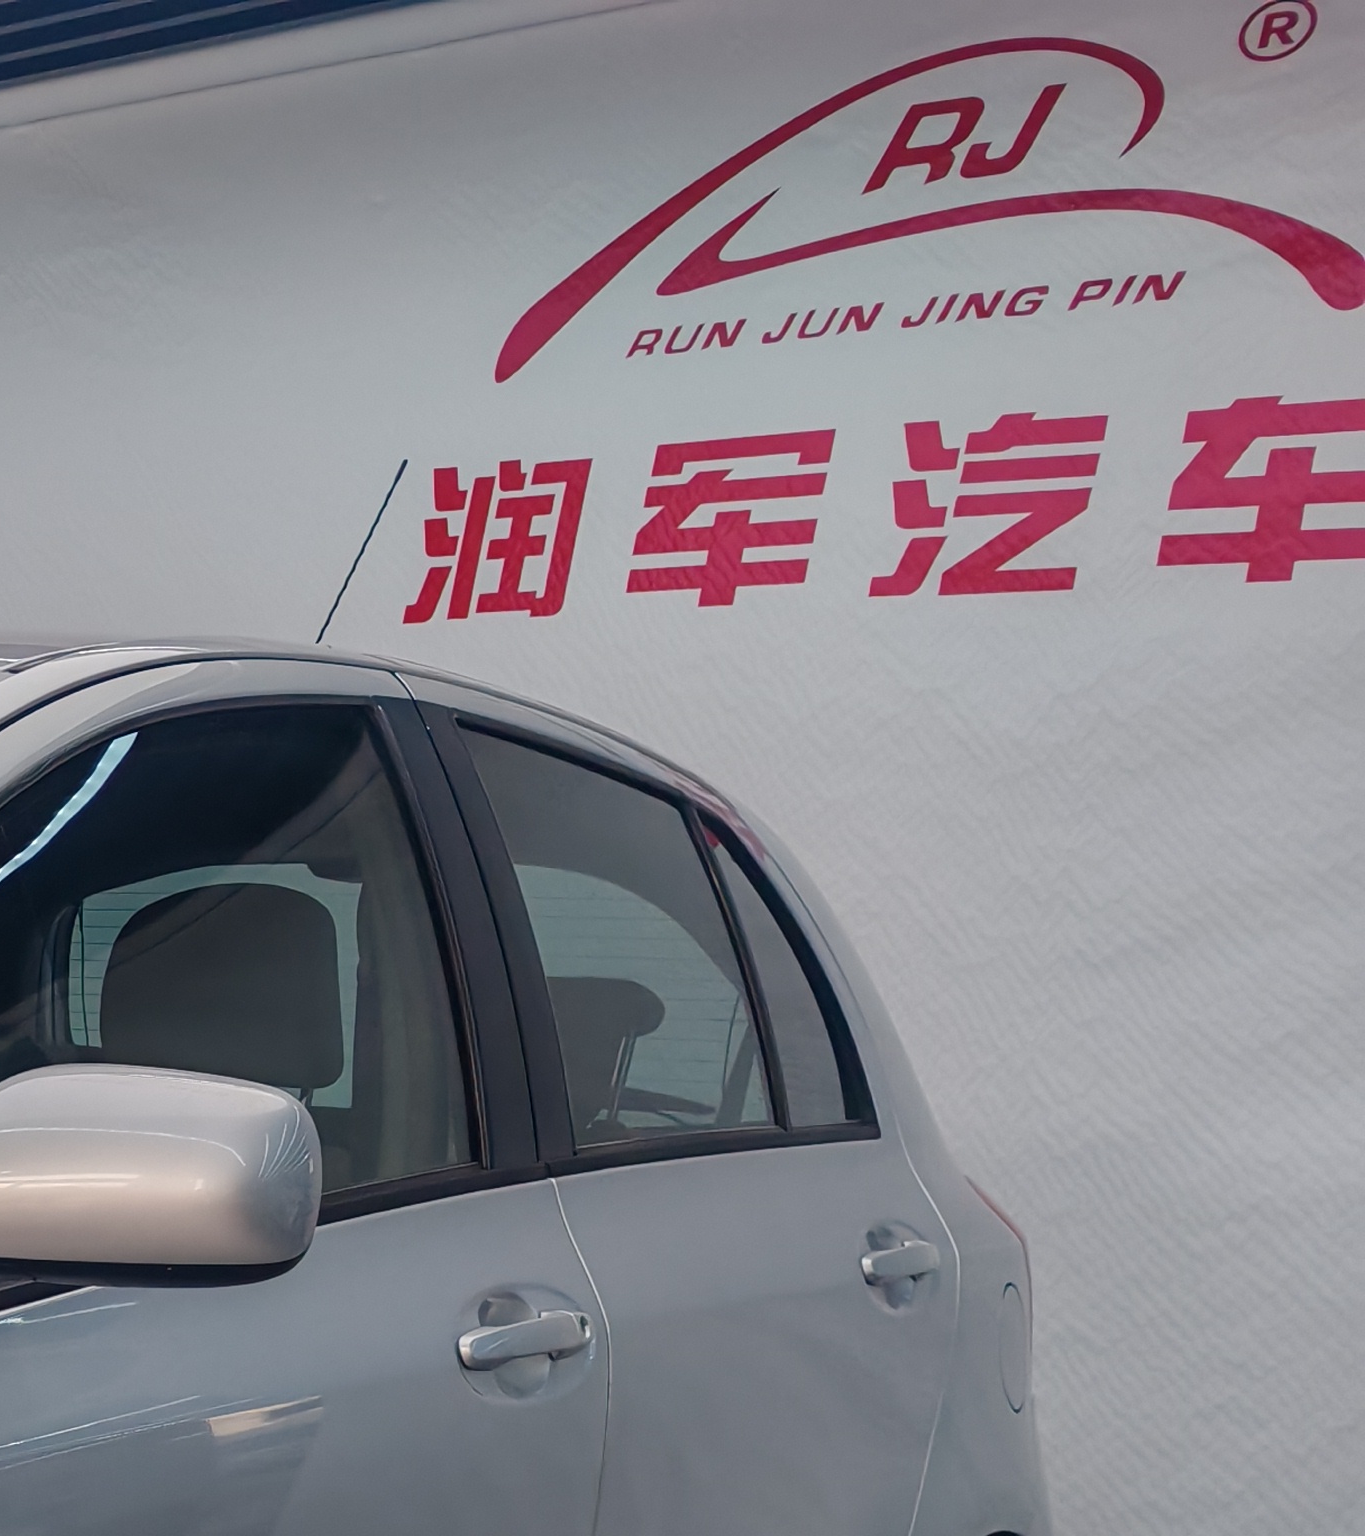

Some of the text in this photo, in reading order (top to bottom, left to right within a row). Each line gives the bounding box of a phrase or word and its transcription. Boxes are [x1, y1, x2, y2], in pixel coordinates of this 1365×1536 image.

[863, 84, 1065, 195] RJ
[625, 270, 1186, 358] RUN JUN JING PIN
[402, 393, 1365, 625] 润军汽车
